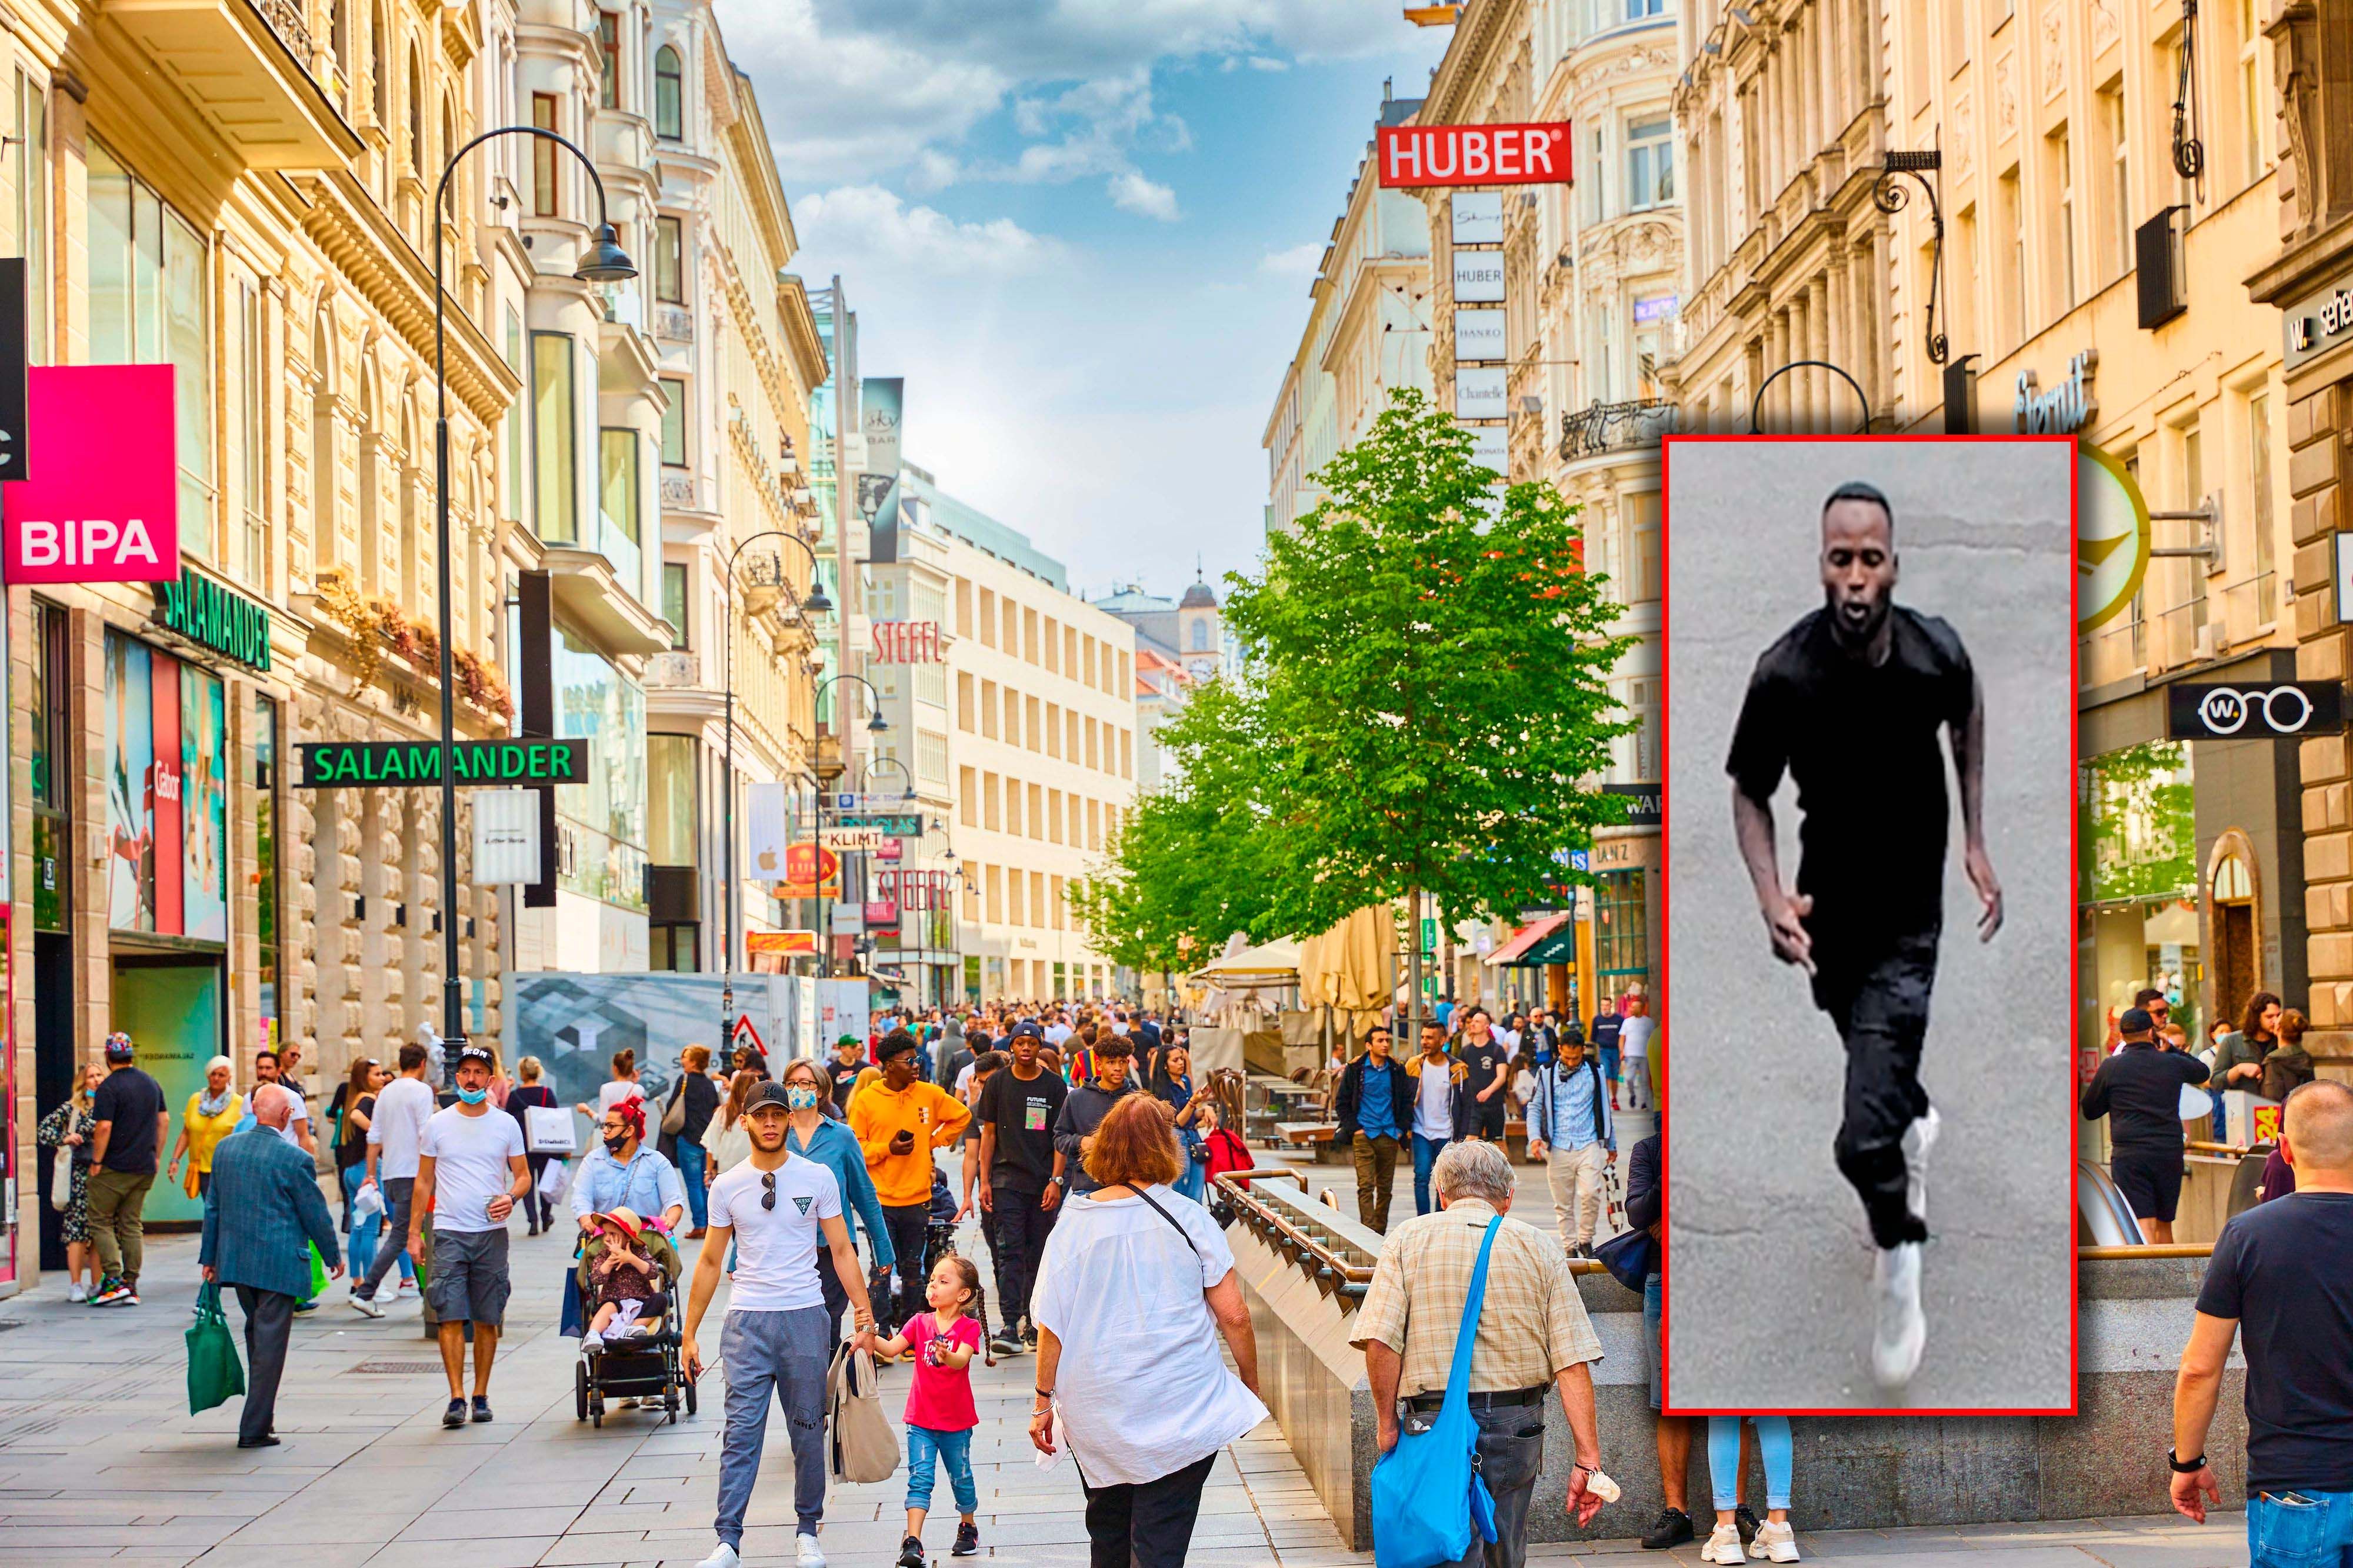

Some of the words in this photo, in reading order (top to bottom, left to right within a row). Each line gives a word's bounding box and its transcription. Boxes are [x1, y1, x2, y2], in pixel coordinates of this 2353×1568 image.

[1389, 129, 1553, 178] HUBER
[1457, 269, 1502, 282] HUBER
[1458, 385, 1504, 400] Chantelle
[21, 519, 159, 566] BIPA
[163, 566, 271, 671] SALAMANDER
[872, 620, 943, 664] STEFFL
[154, 759, 180, 801] Gabor
[315, 743, 573, 782] SALAMANDER
[830, 832, 881, 846] KLIMT
